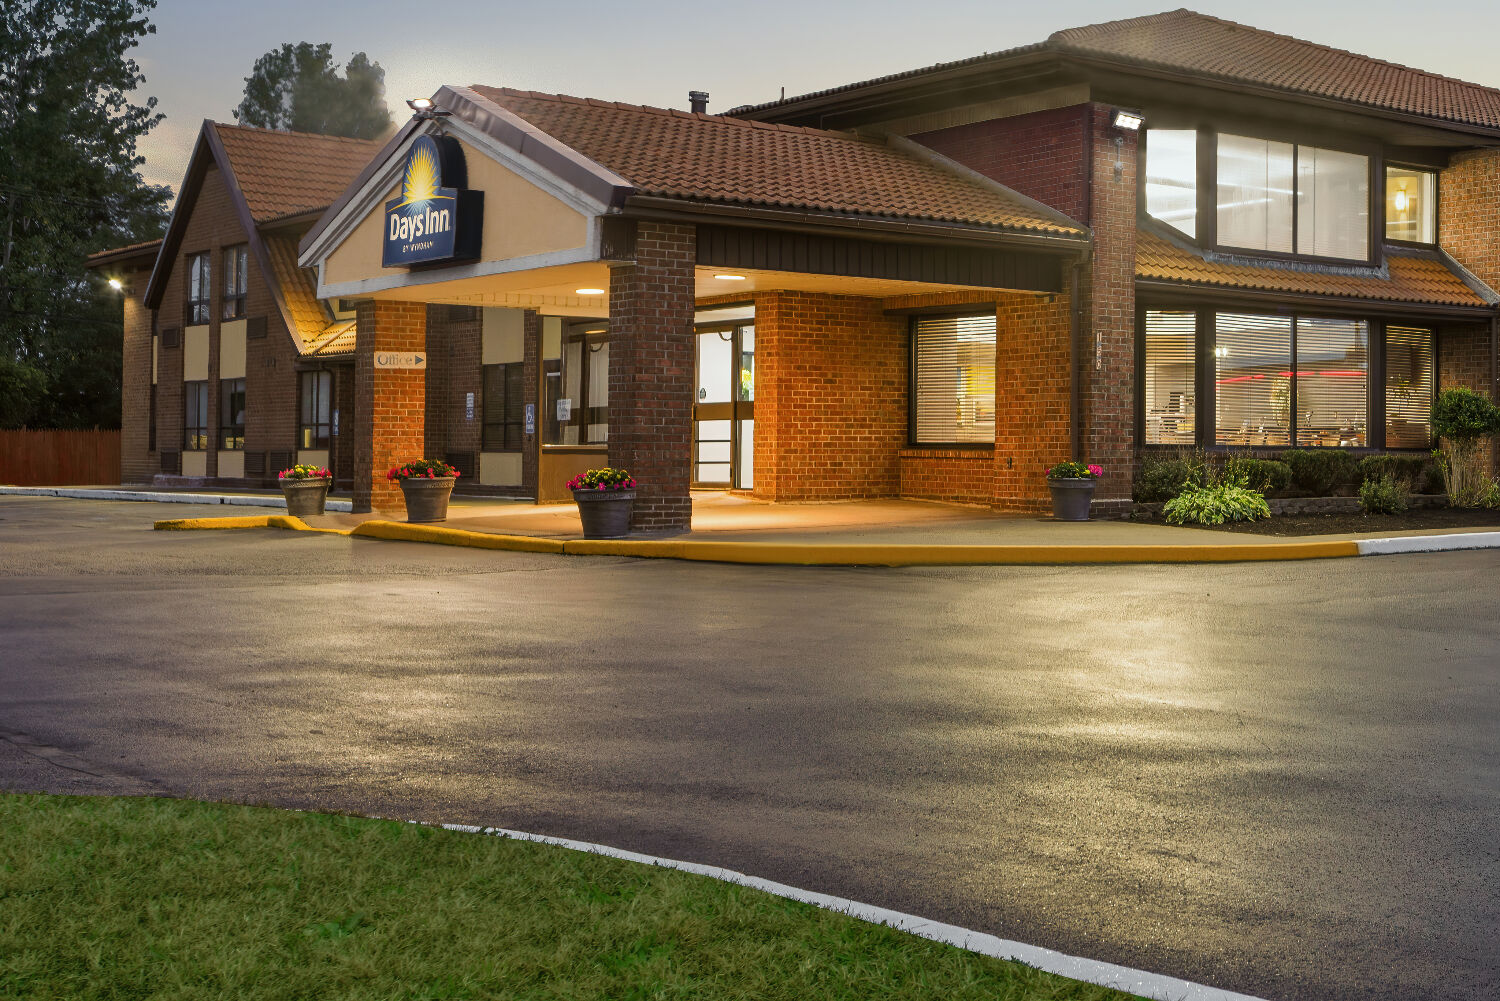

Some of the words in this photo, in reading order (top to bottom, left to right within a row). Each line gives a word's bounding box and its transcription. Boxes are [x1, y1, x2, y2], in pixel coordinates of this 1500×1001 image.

[390, 213, 424, 242] Days
[425, 206, 449, 235] Inn
[377, 354, 413, 366] Office
